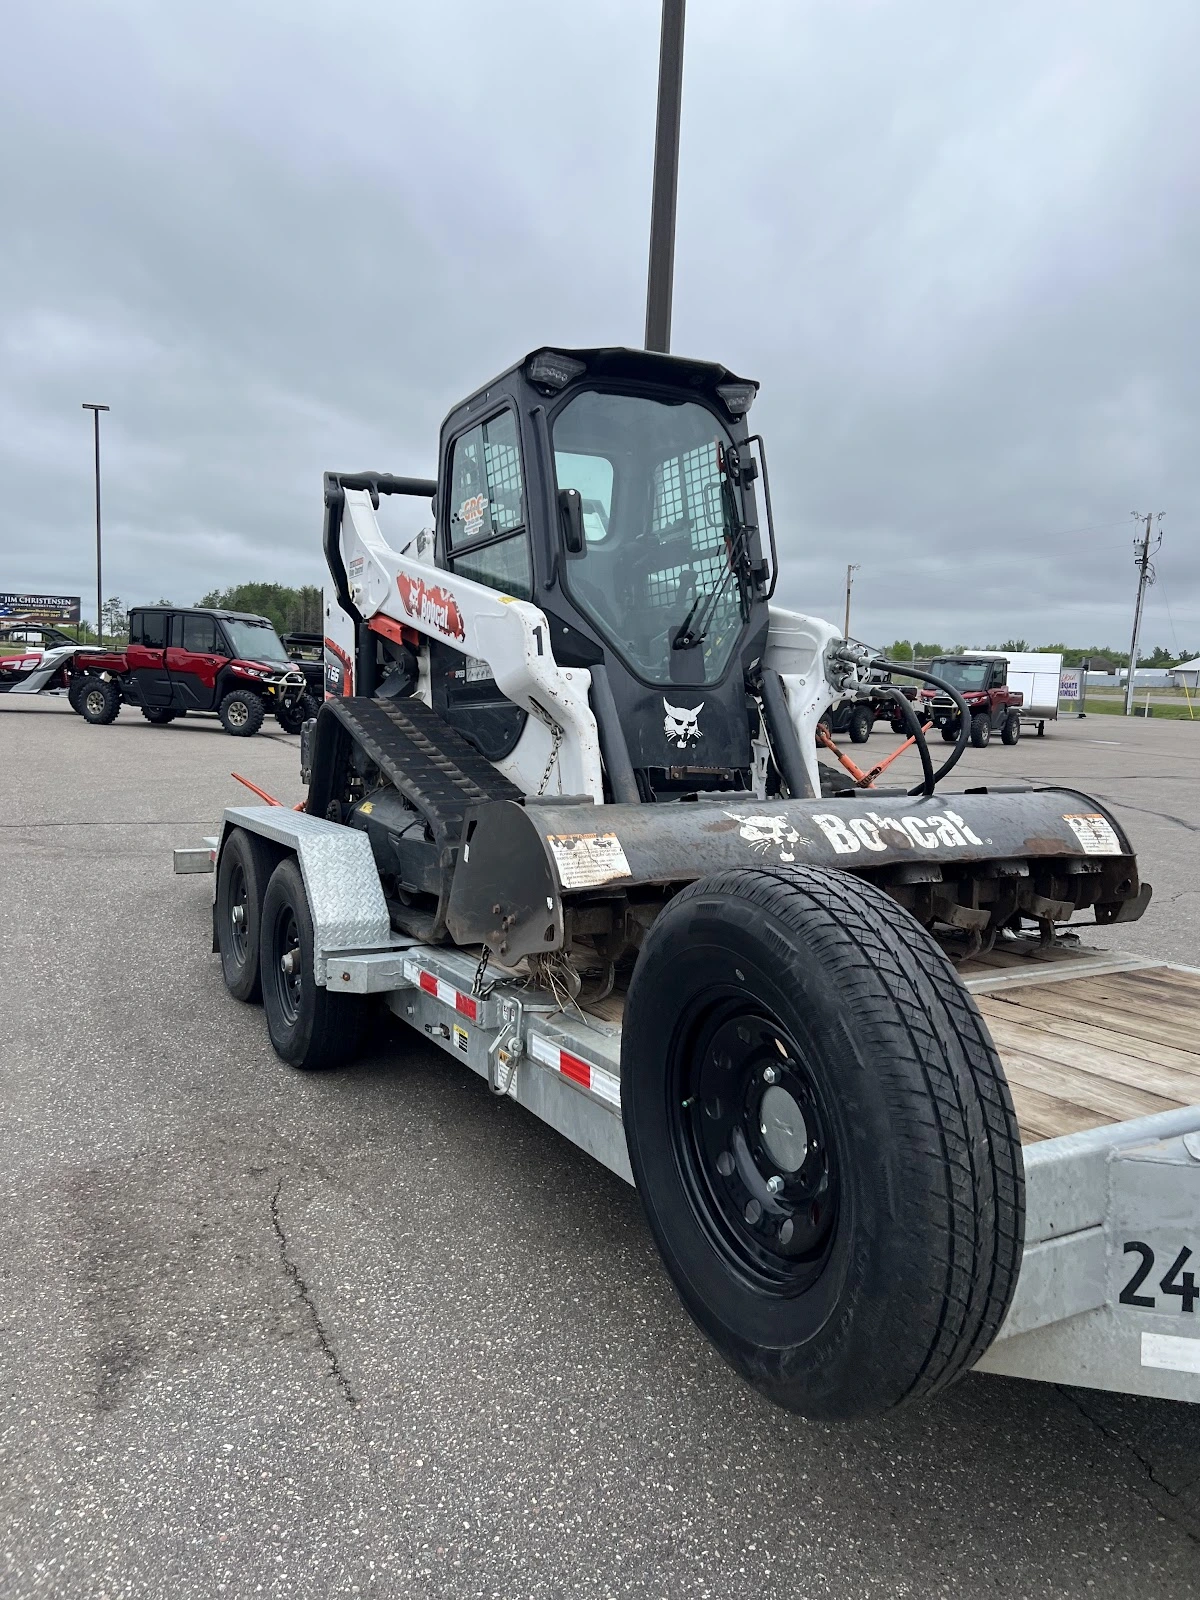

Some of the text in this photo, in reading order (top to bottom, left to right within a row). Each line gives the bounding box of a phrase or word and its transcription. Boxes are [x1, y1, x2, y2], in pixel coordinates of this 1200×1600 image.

[19, 597, 71, 605] CHRISTENSEN
[421, 593, 449, 629] Bobcat
[532, 625, 543, 656] 1
[812, 810, 983, 854] Bobcat
[1119, 1241, 1200, 1313] 24
